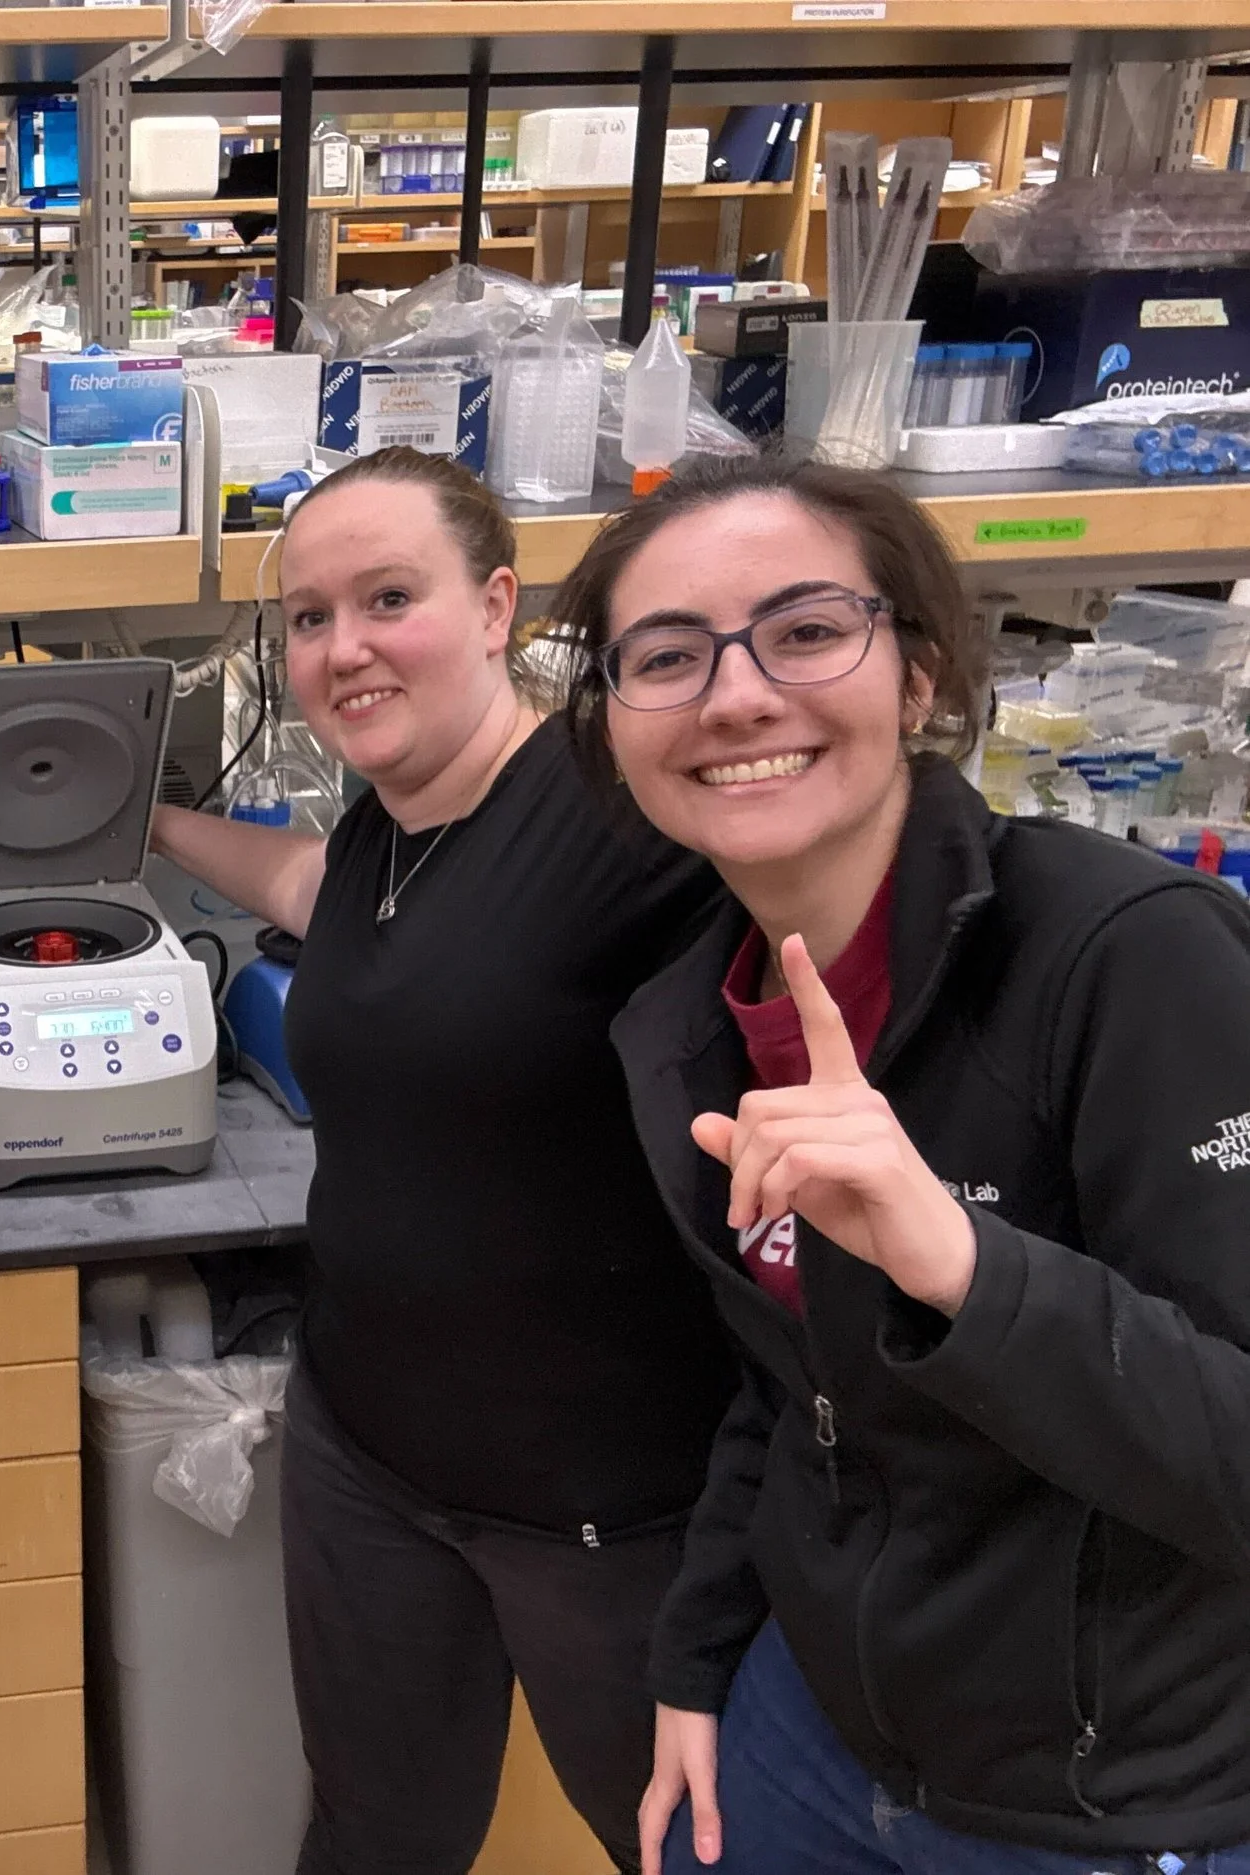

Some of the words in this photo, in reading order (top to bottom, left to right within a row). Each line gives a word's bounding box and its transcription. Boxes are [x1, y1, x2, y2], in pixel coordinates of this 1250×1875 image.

[832, 8, 875, 17] PURIFICATION
[69, 373, 162, 392] fisherbrand
[322, 365, 355, 402] QIAGEN
[1106, 371, 1234, 401] proteintech
[447, 431, 476, 464] IAGEN
[159, 454, 172, 467] M
[1215, 1112, 1250, 1136] THE
[3, 1136, 64, 1151] eppendorf
[102, 1132, 156, 1145] Centrifuge
[158, 1127, 183, 1139] 5425
[1191, 1131, 1250, 1164] NORT
[1217, 1147, 1250, 1172] FAC
[963, 1181, 1000, 1202] Lab
